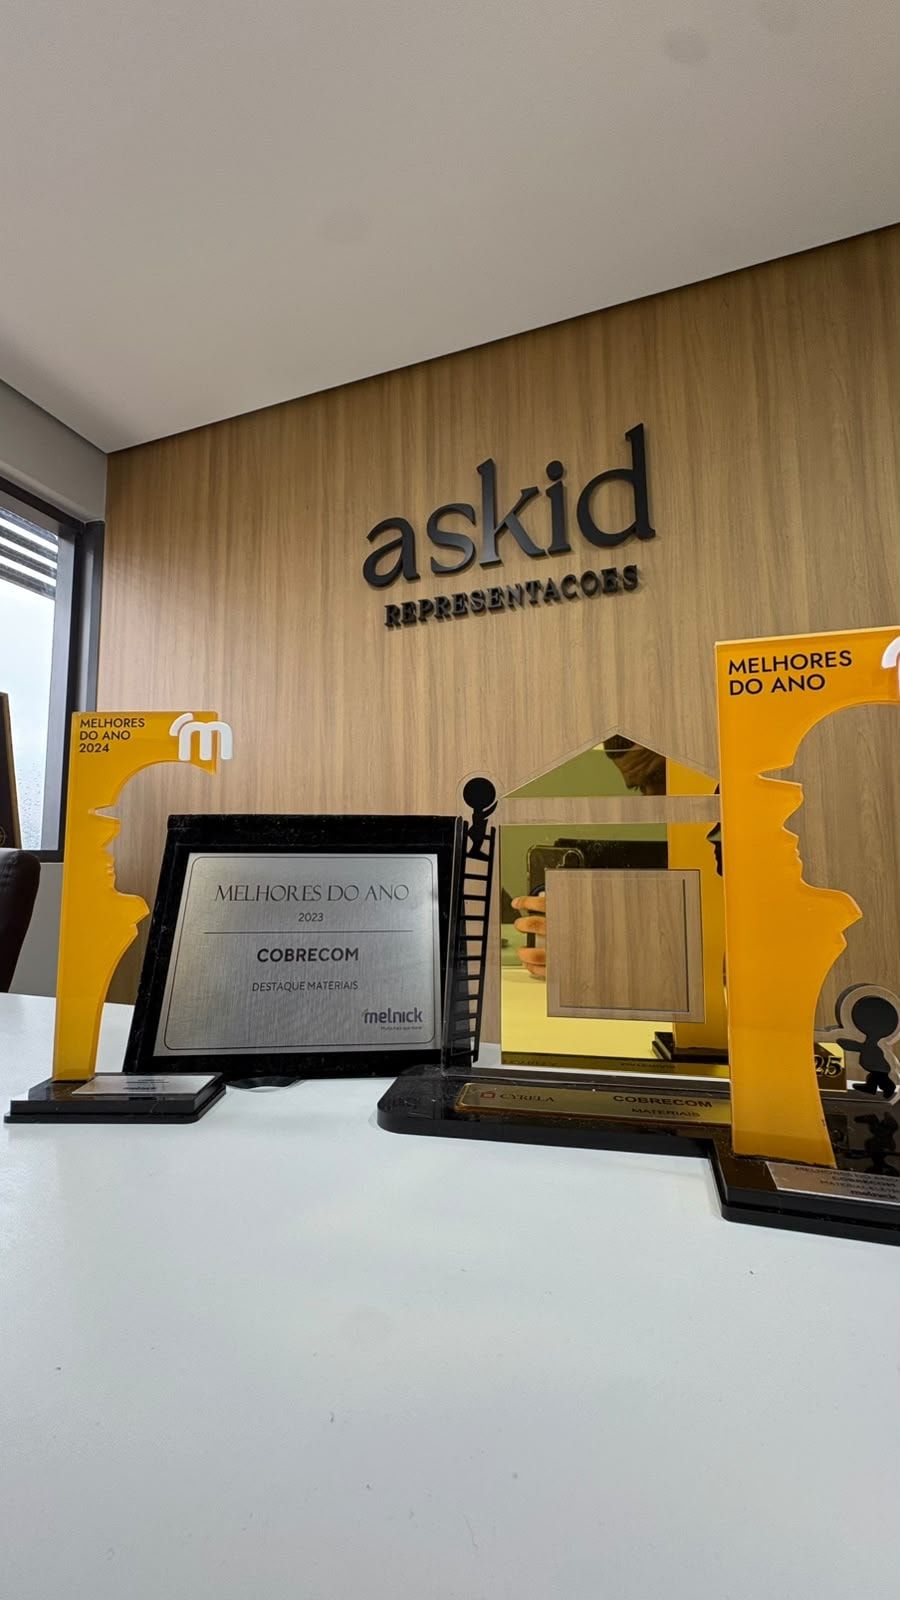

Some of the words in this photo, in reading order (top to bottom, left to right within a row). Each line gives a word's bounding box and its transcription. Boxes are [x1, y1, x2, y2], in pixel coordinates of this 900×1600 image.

[362, 423, 656, 588] askid
[384, 565, 640, 628] REPRESENTACOES
[728, 650, 853, 675] MELHORES
[729, 678, 764, 696] DO
[771, 674, 826, 693] ANO
[80, 718, 145, 728] MELHORES
[79, 730, 99, 741] DO
[102, 730, 131, 741] ANO
[79, 743, 110, 753] 2024
[215, 884, 322, 902] MELHORES
[328, 884, 360, 901] DO
[365, 884, 410, 901] ANO
[298, 912, 324, 922] 2023
[257, 947, 359, 963] COBRECOM
[252, 981, 305, 993] DESTAQUE
[307, 980, 359, 991] MATERIAIS
[362, 1007, 423, 1024] melnick
[500, 1093, 554, 1103] CYRELA
[613, 1095, 713, 1108] COBRECOM
[632, 1108, 700, 1117] MATERIAIS
